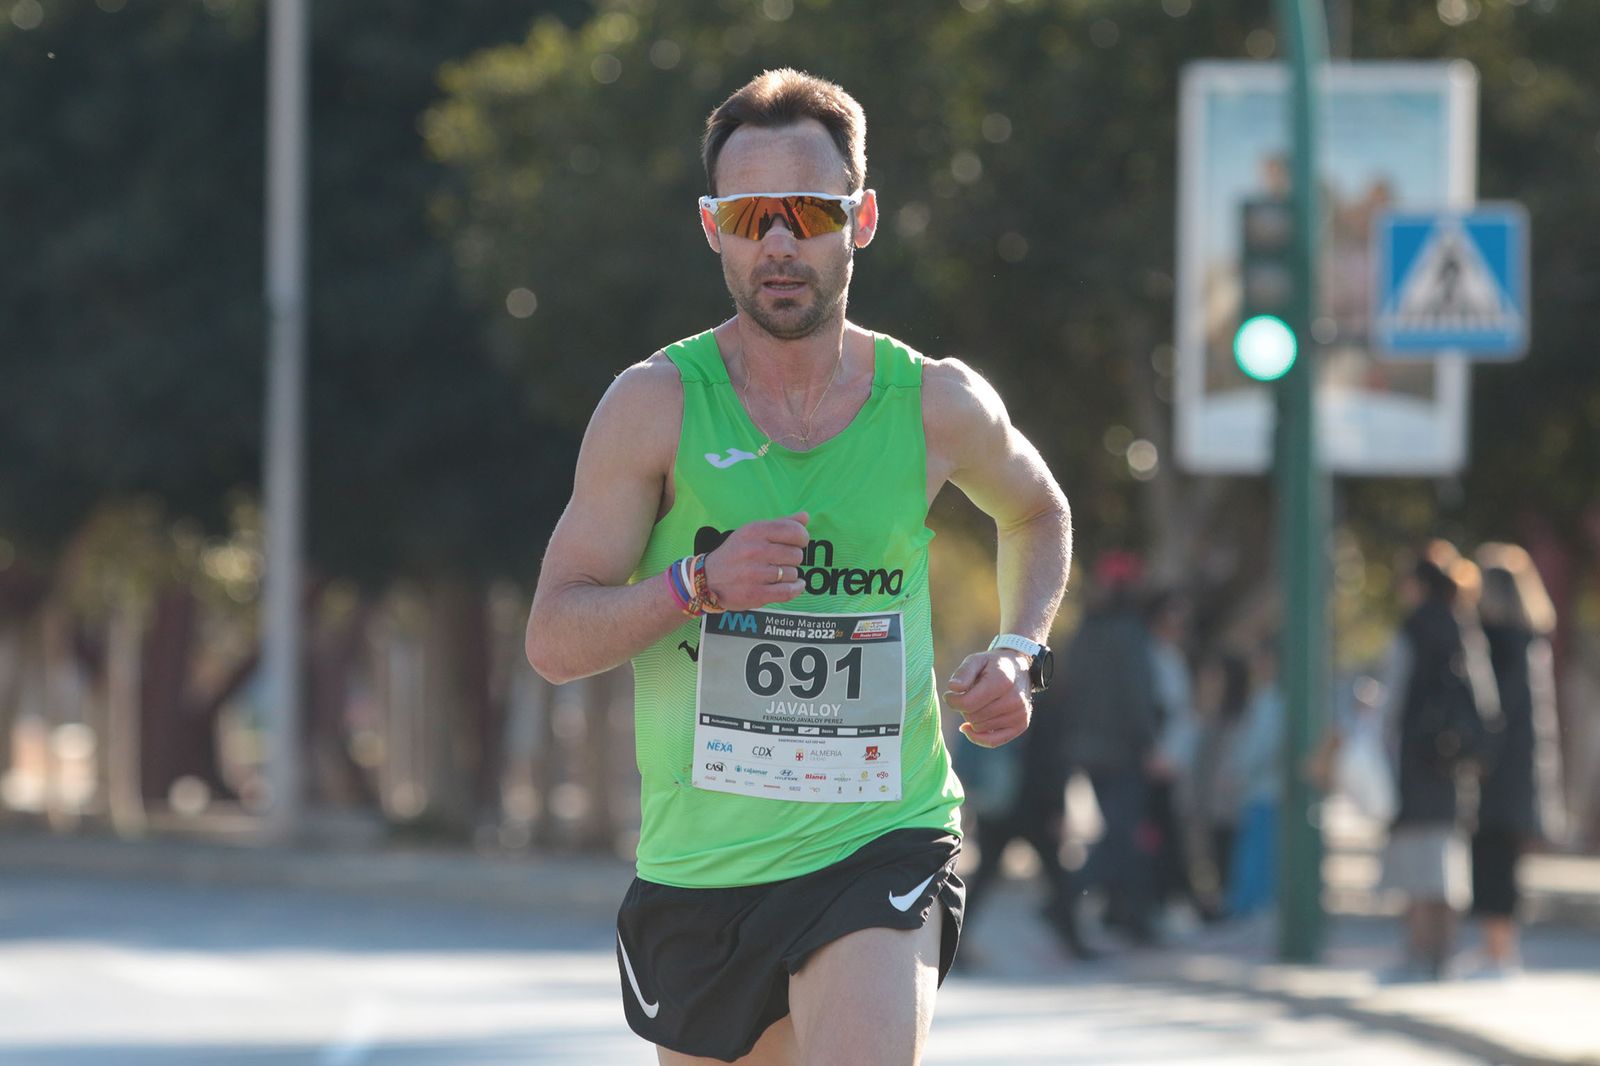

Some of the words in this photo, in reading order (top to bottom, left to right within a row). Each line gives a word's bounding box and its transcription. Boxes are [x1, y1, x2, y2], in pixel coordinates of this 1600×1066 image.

[765, 616, 795, 627] Medio
[798, 619, 837, 629] Maratón
[764, 625, 806, 638] Almería
[808, 629, 835, 639] 2022
[745, 643, 863, 700] 691
[766, 701, 841, 717] JAVALOY
[763, 715, 795, 723] FERNANDO
[706, 741, 733, 753] NEXA
